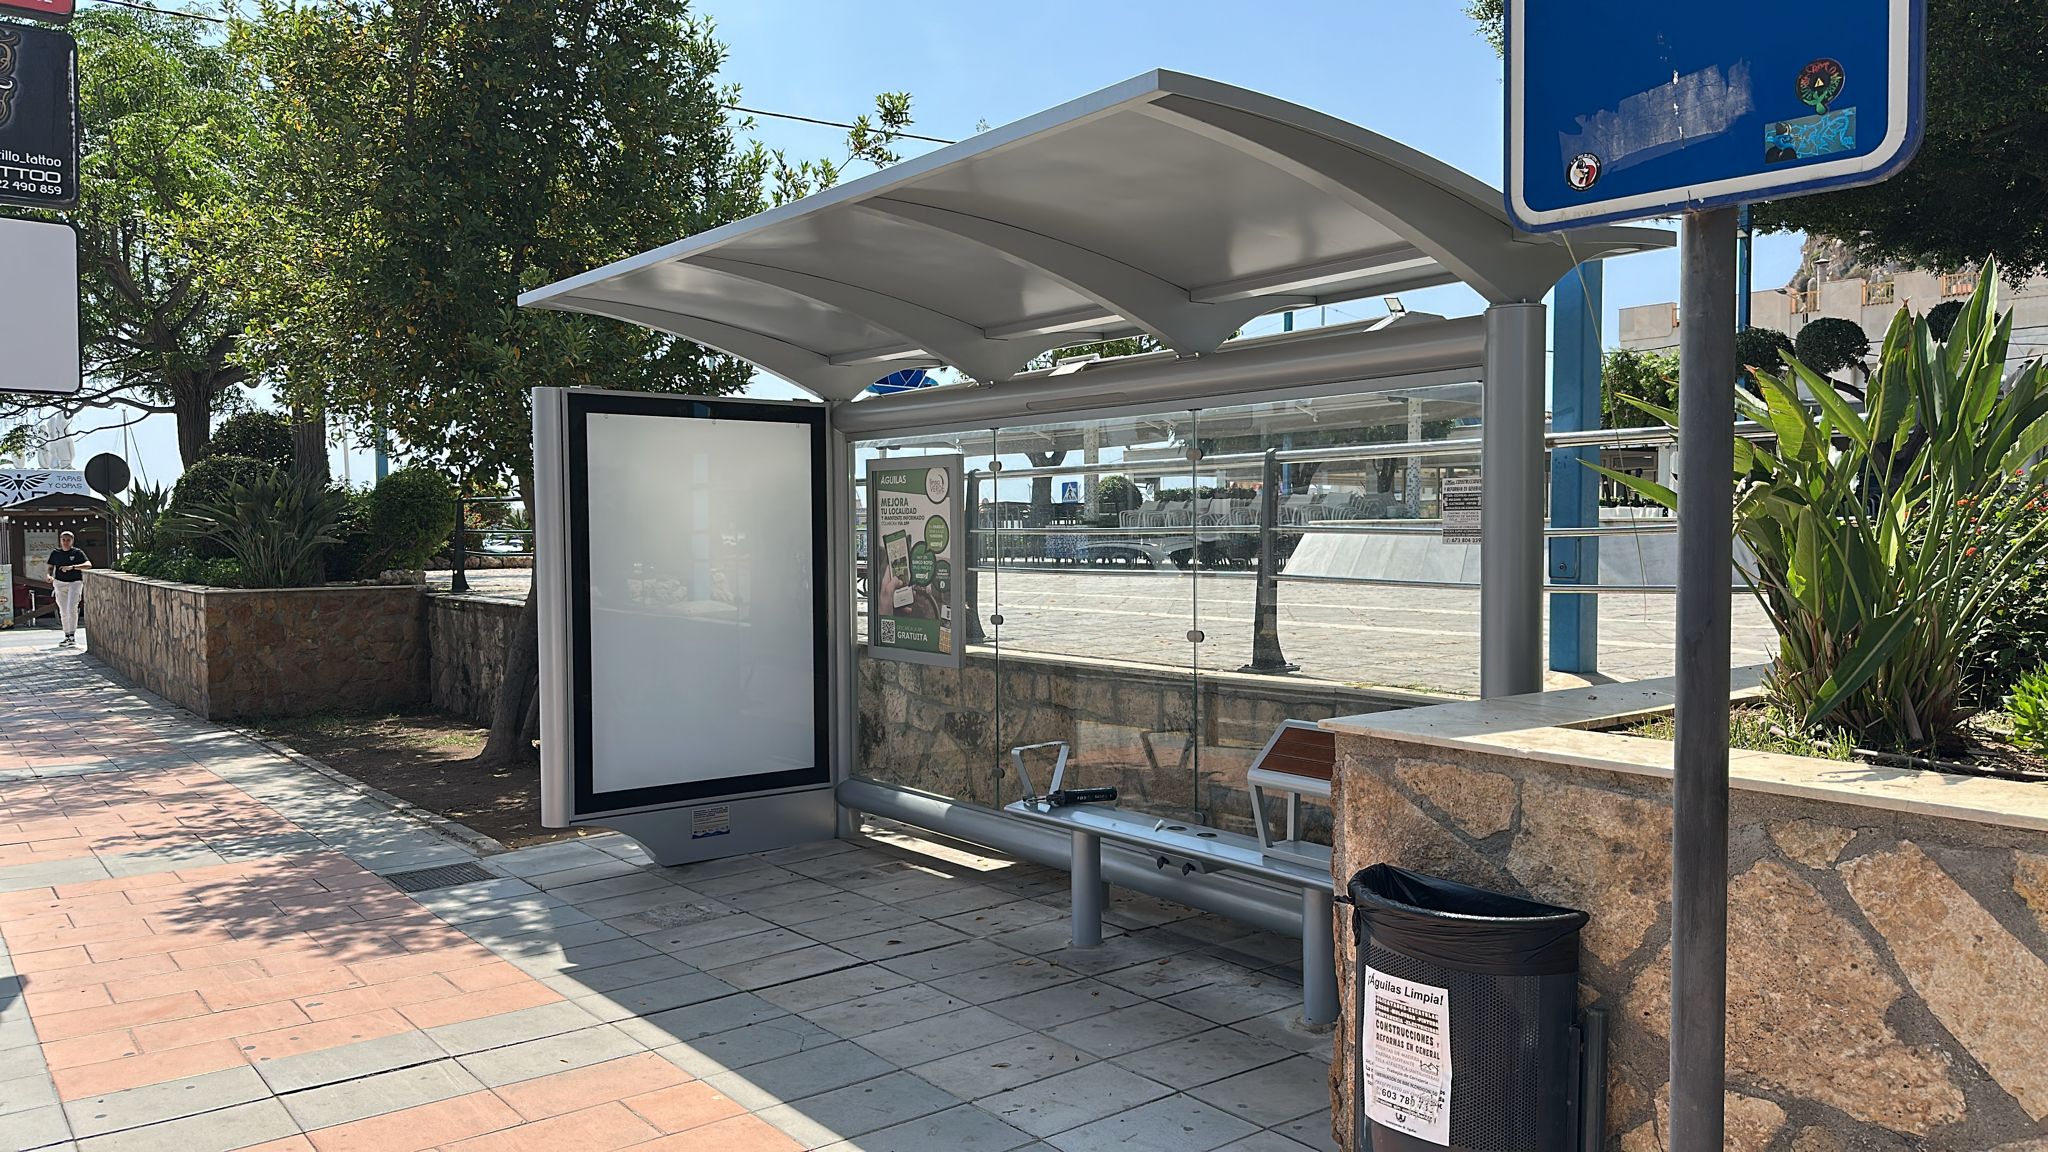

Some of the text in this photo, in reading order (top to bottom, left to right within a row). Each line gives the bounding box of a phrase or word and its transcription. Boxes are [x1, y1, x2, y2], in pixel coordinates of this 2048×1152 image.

[0, 180, 62, 195] 2 490 859
[880, 474, 907, 485] ÁGUILAS
[880, 498, 909, 507] MEJORA
[897, 632, 928, 642] GRATUITA
[1404, 986, 1444, 1005] Limpia!
[1376, 1020, 1434, 1046] CONSTRUCCIONES
[1376, 1033, 1440, 1060] REFORMAS EN GENERAL
[1381, 1088, 1397, 1100] 603
